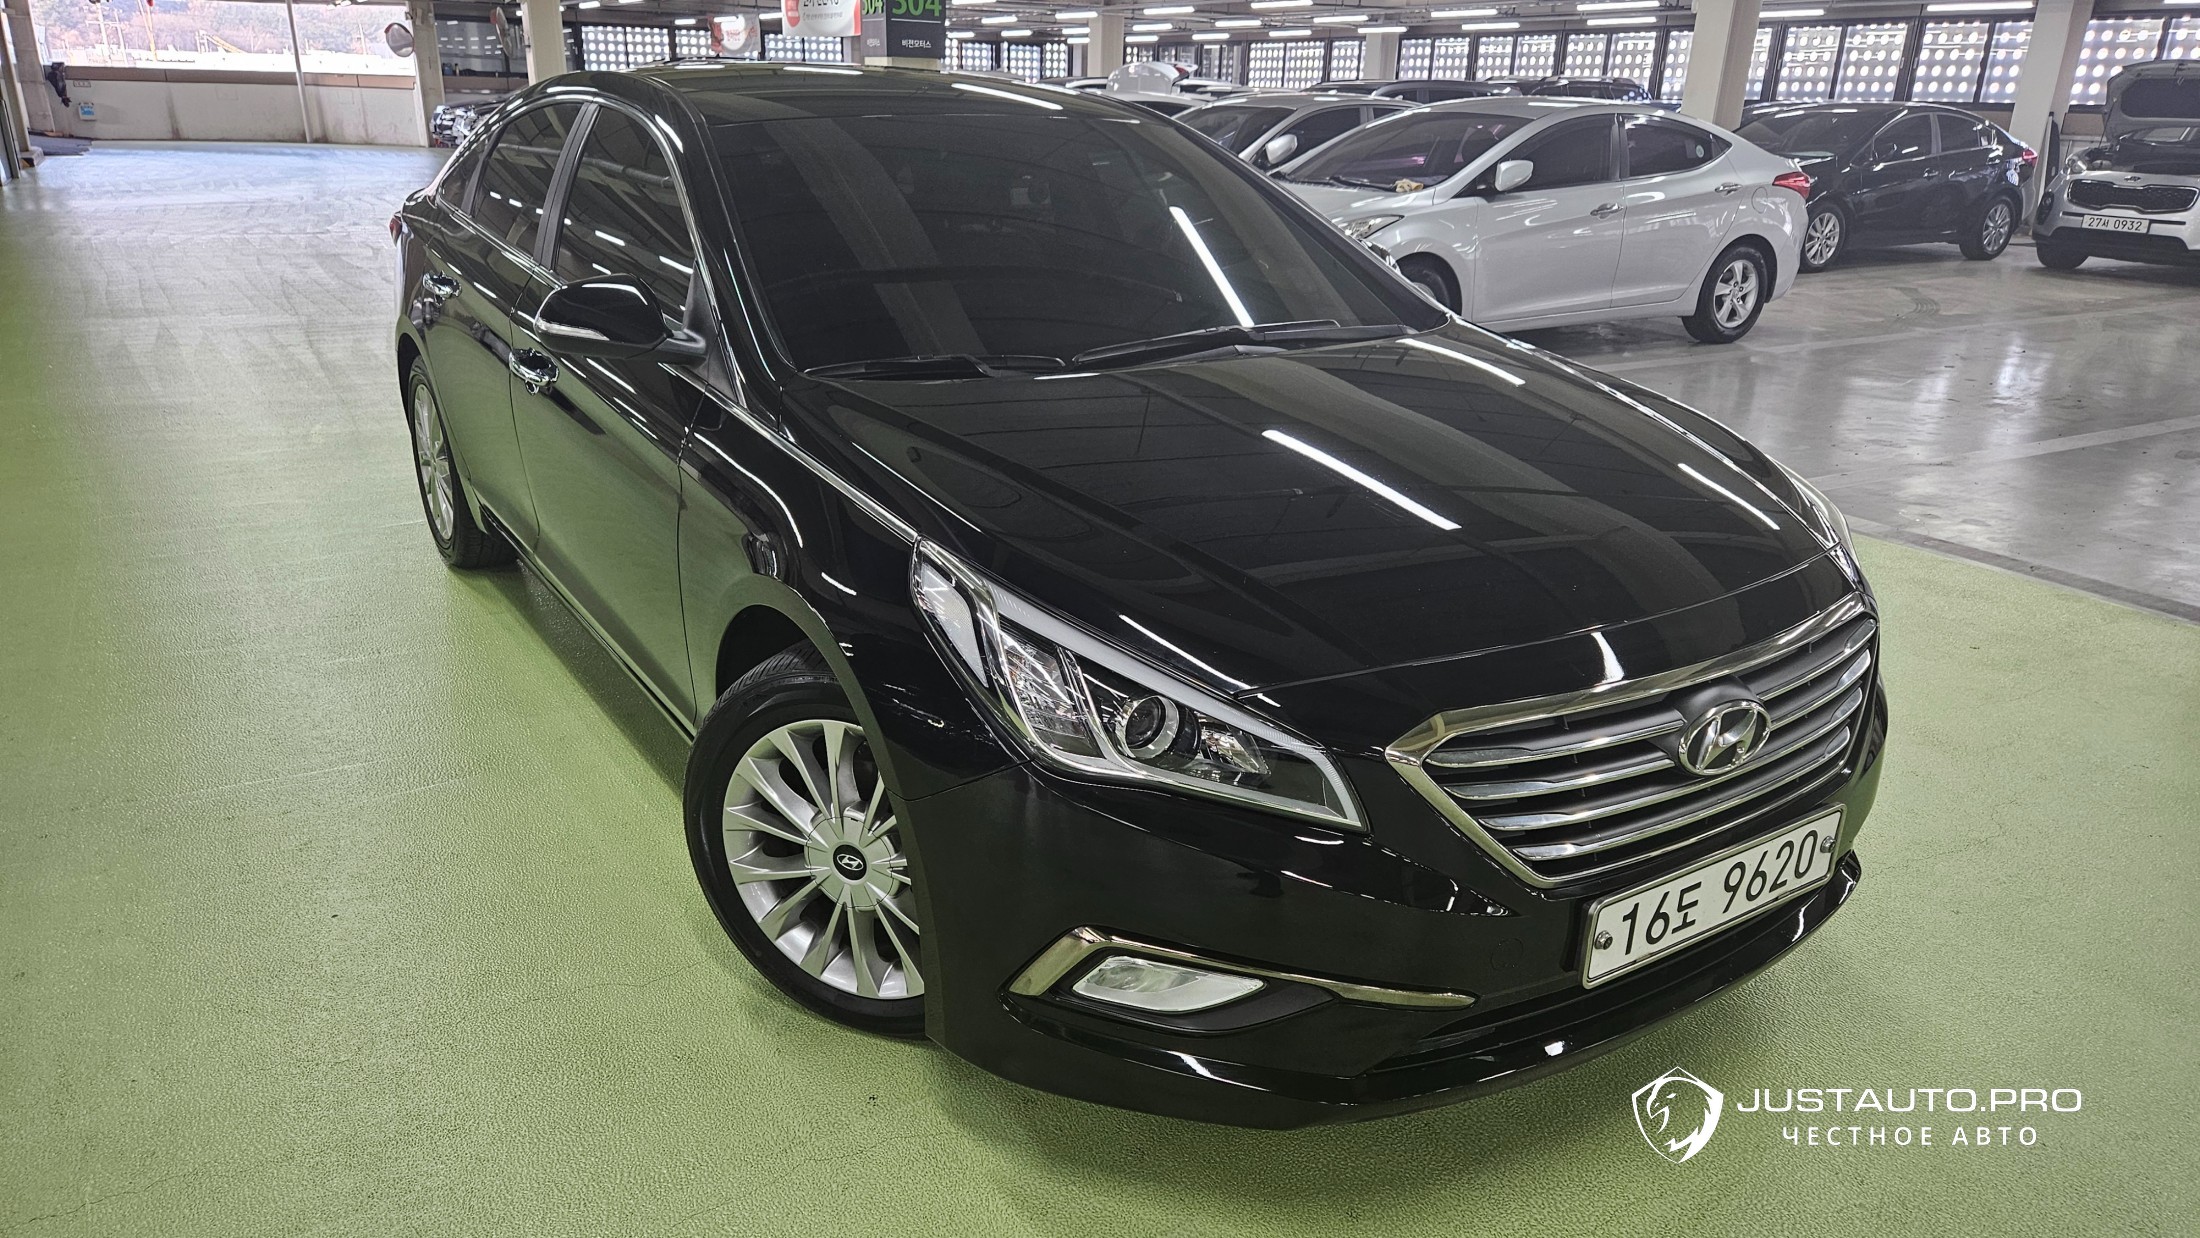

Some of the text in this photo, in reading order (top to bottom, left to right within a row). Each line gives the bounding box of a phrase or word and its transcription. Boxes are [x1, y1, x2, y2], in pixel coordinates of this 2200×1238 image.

[2113, 219, 2143, 231] 0932
[1622, 829, 1819, 956] 16도 9620
